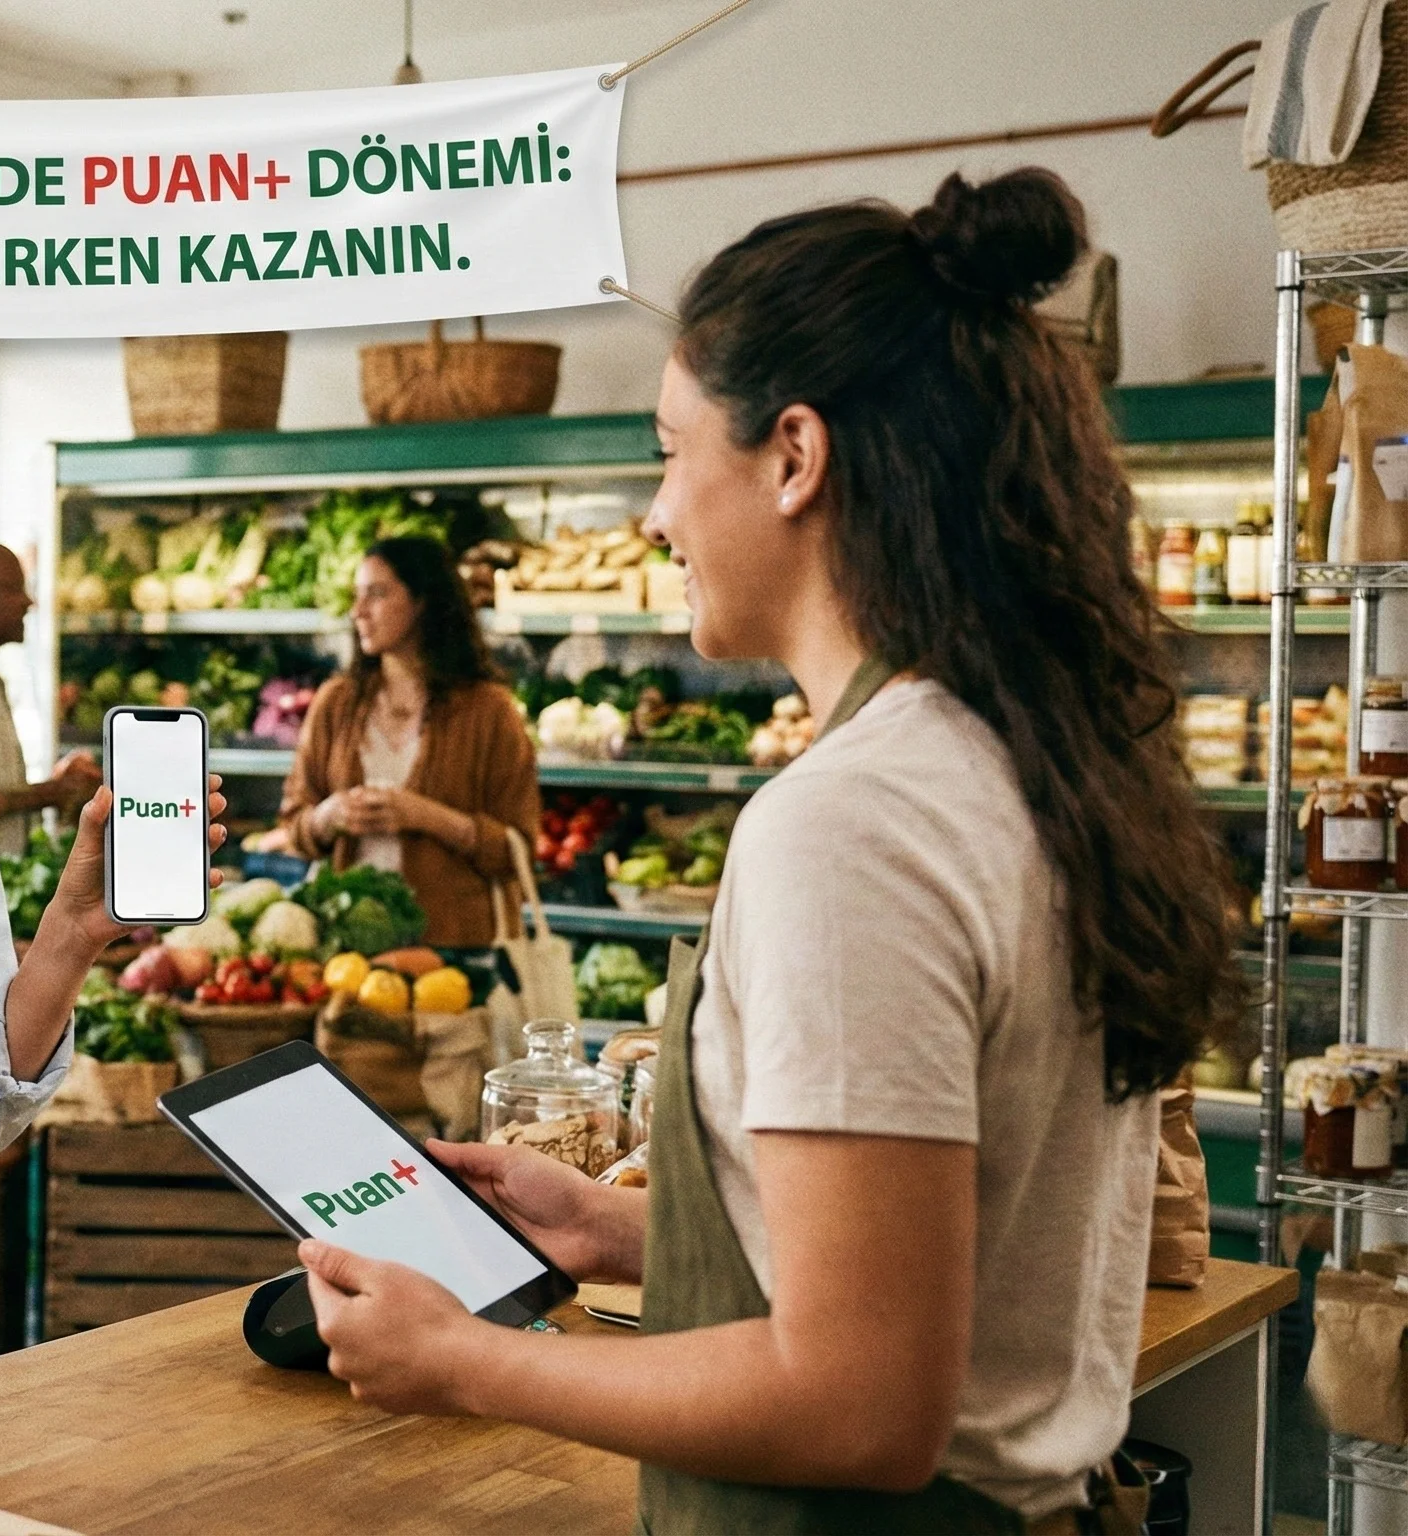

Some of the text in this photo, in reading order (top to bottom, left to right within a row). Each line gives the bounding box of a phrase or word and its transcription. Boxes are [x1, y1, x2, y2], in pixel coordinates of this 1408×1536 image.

[82, 152, 291, 206] PUAN+
[307, 122, 572, 198] DÖNEMİ:
[178, 222, 471, 284] KAZANIN.
[120, 797, 197, 818] Puan+
[301, 1159, 420, 1228] Puan+
